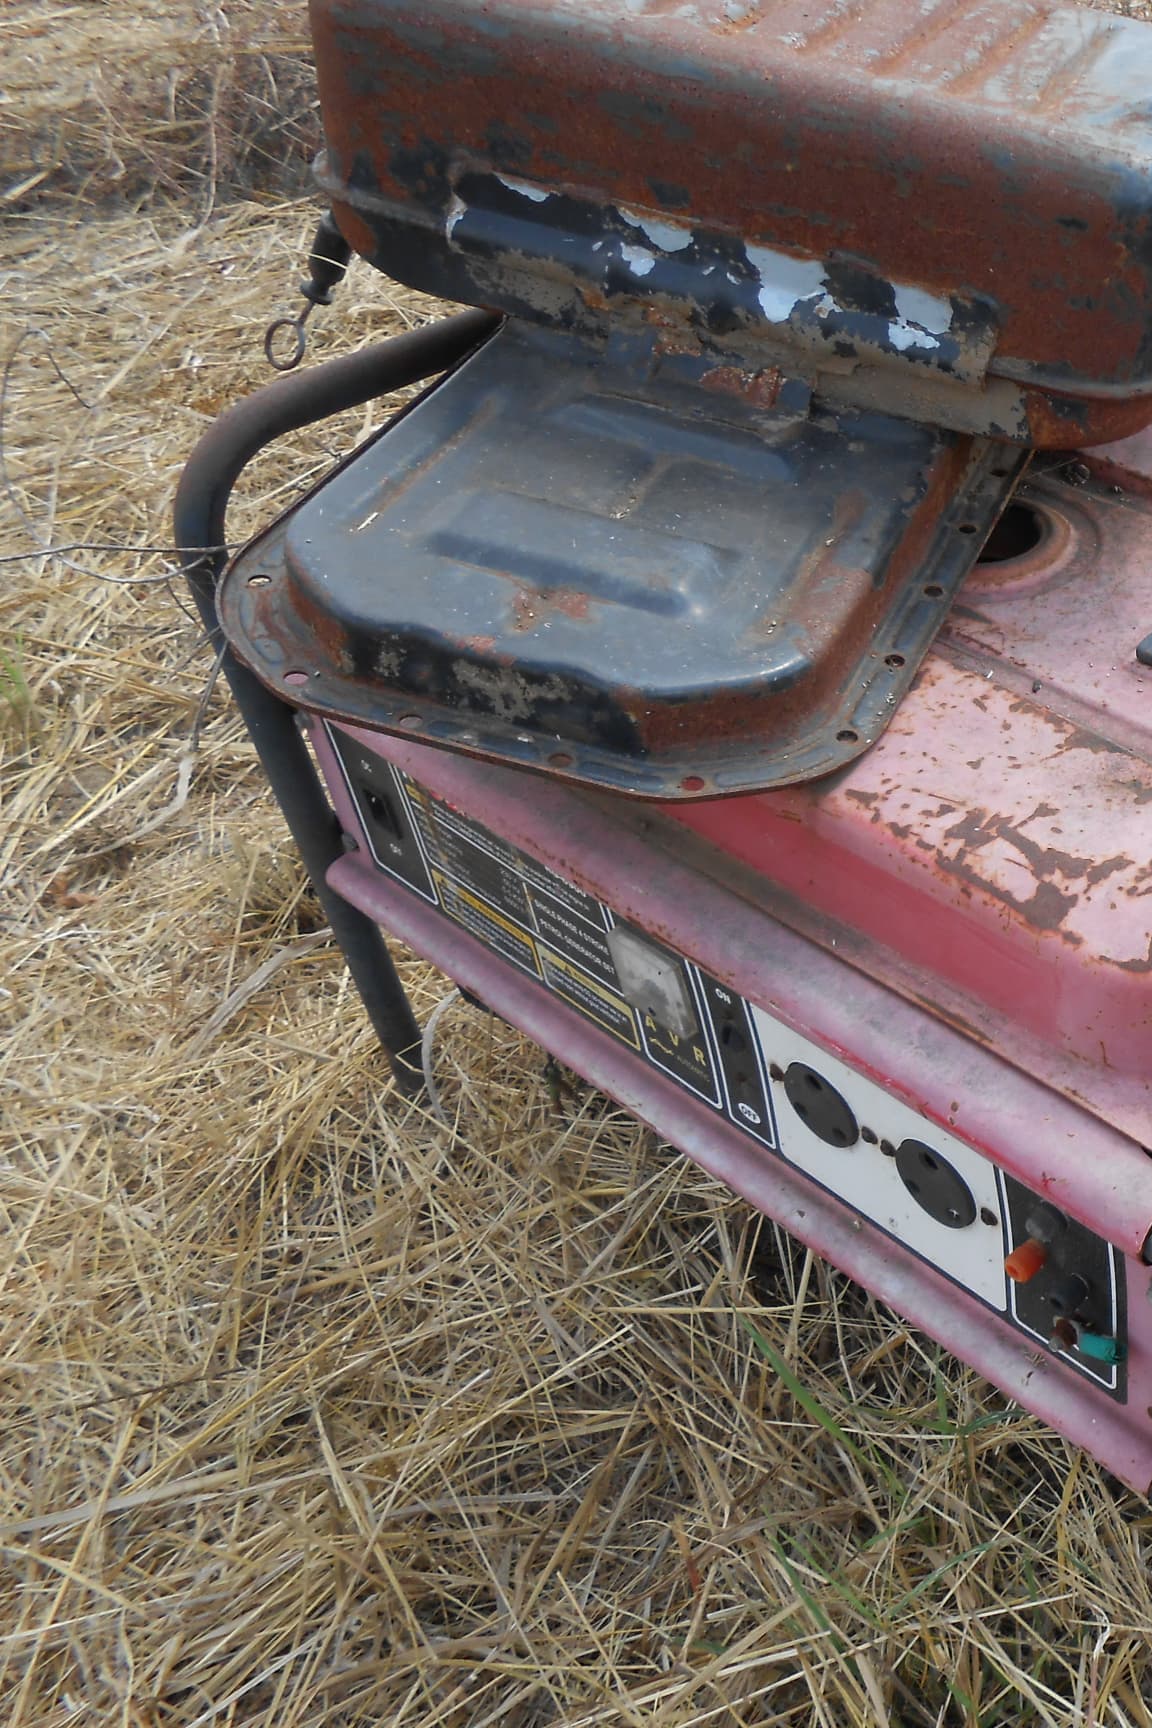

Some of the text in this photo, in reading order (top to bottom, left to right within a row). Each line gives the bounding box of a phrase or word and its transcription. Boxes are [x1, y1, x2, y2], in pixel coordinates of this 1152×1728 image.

[556, 914, 577, 934] PHASE
[540, 918, 563, 940] PETROL
[563, 935, 602, 965] GENERATOR
[602, 960, 615, 974] SET
[715, 988, 731, 1004] ON
[741, 1106, 758, 1121] OFF
